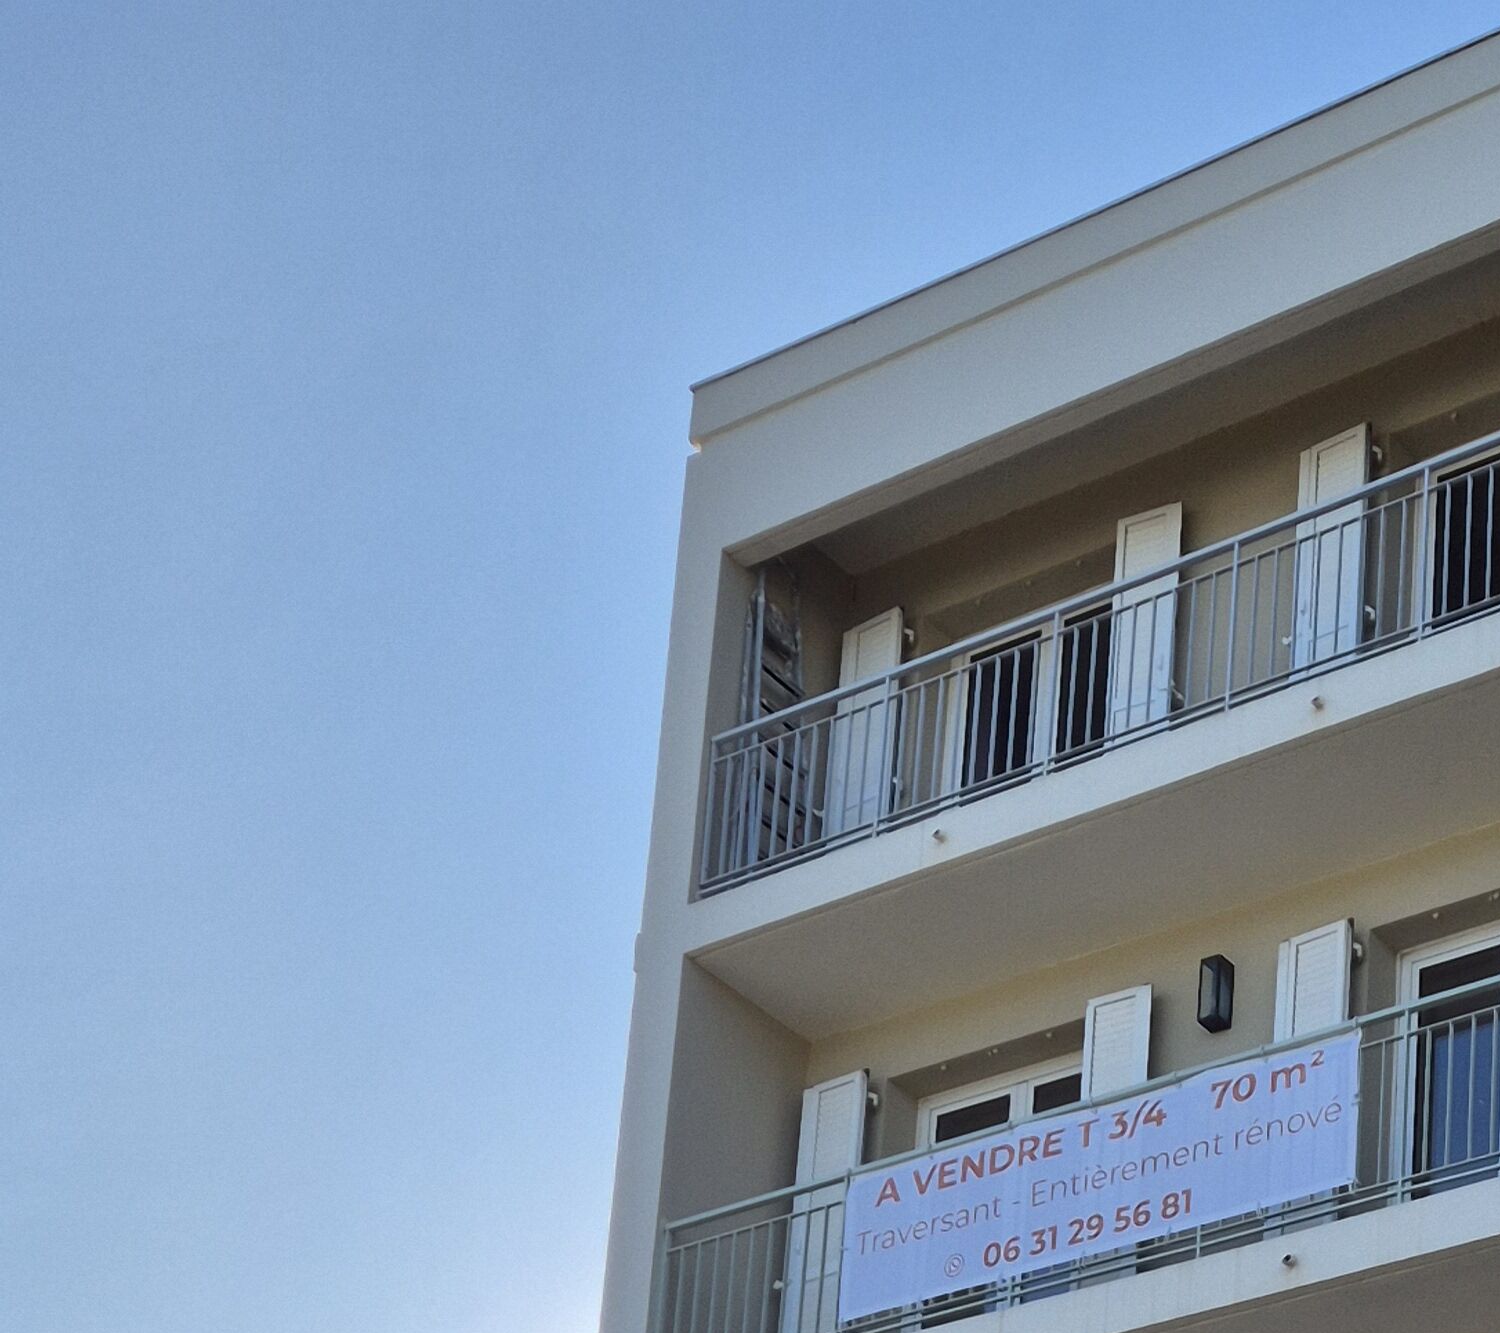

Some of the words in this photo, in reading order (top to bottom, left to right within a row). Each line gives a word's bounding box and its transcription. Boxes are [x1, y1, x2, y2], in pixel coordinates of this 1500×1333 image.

[856, 1196, 1002, 1255] Traversant
[1031, 1133, 1224, 1207] Entièrement
[1234, 1094, 1343, 1151] rénové
[874, 1176, 900, 1208] A
[912, 1128, 1065, 1196] VENDRE
[1078, 1118, 1099, 1148] T
[1107, 1099, 1168, 1140] 3/4
[1210, 1072, 1257, 1110] 70
[1270, 1049, 1325, 1093] m²
[983, 1235, 1022, 1268] 06
[1029, 1224, 1058, 1256] 31
[1067, 1213, 1105, 1247] 29
[1113, 1199, 1151, 1233] 56
[1160, 1187, 1193, 1220] 81
